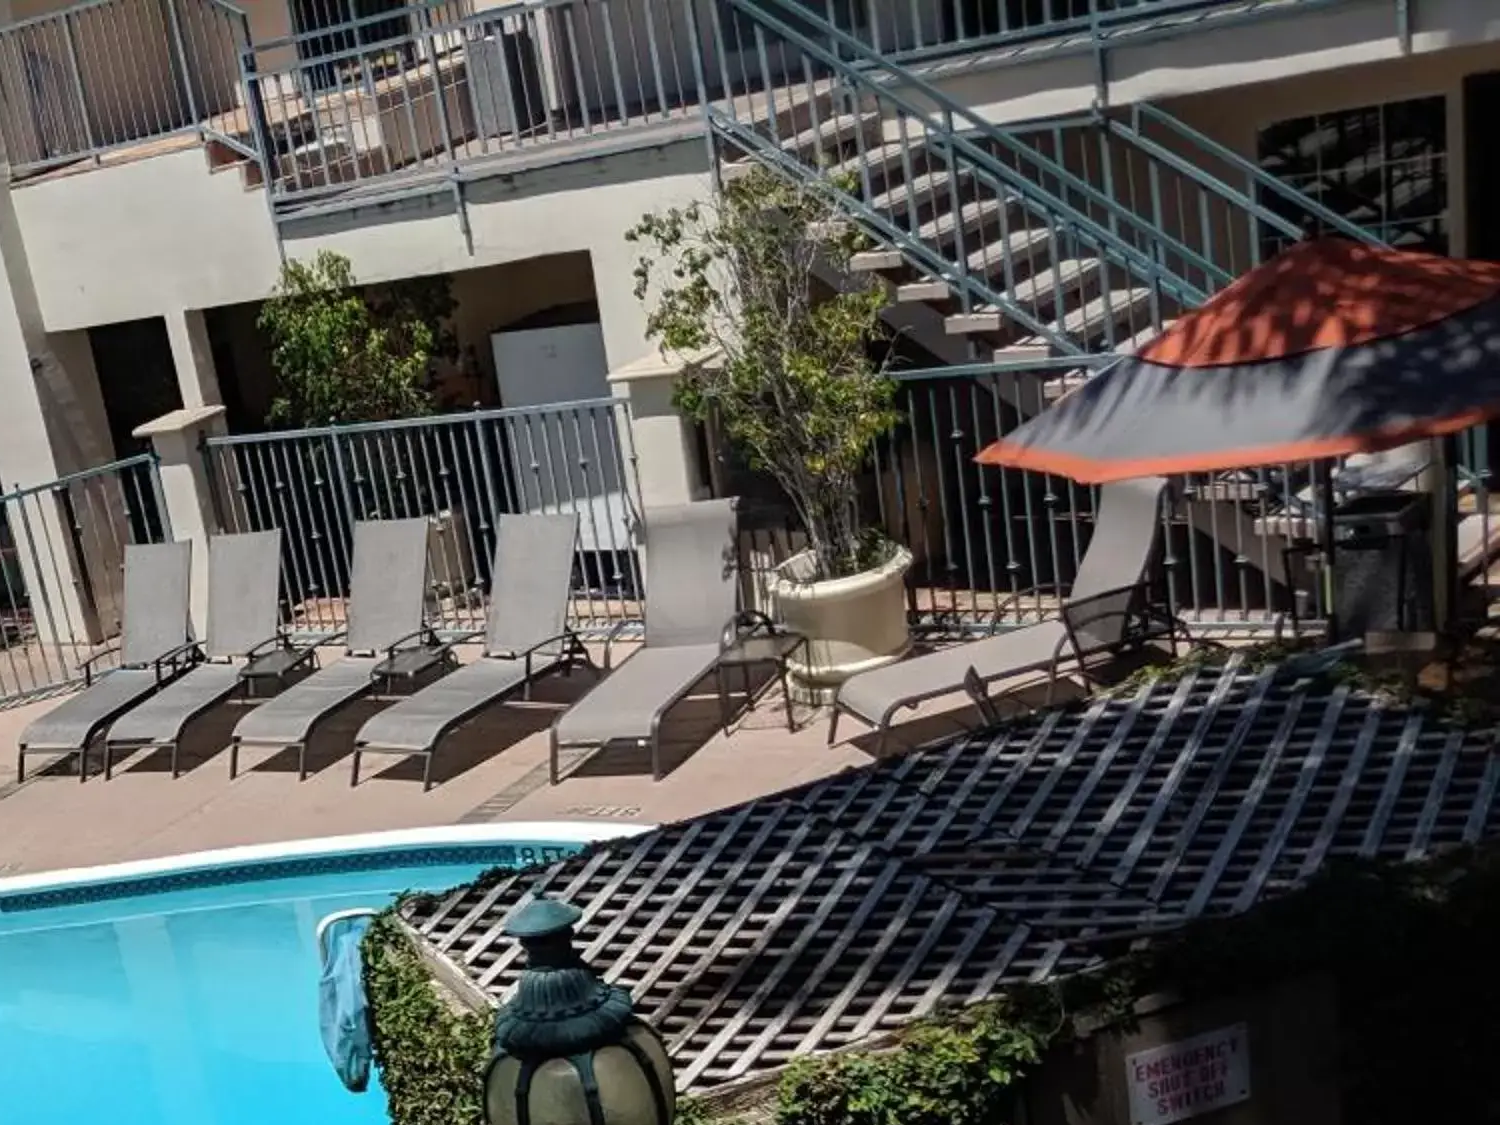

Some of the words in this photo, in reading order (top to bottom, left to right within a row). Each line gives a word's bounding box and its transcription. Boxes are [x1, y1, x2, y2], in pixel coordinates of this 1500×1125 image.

[1135, 1037, 1238, 1083] EMERGENCY
[1148, 1069, 1194, 1098] SHUT
[1199, 1061, 1228, 1084] OFF
[1156, 1080, 1225, 1116] SWITCH
